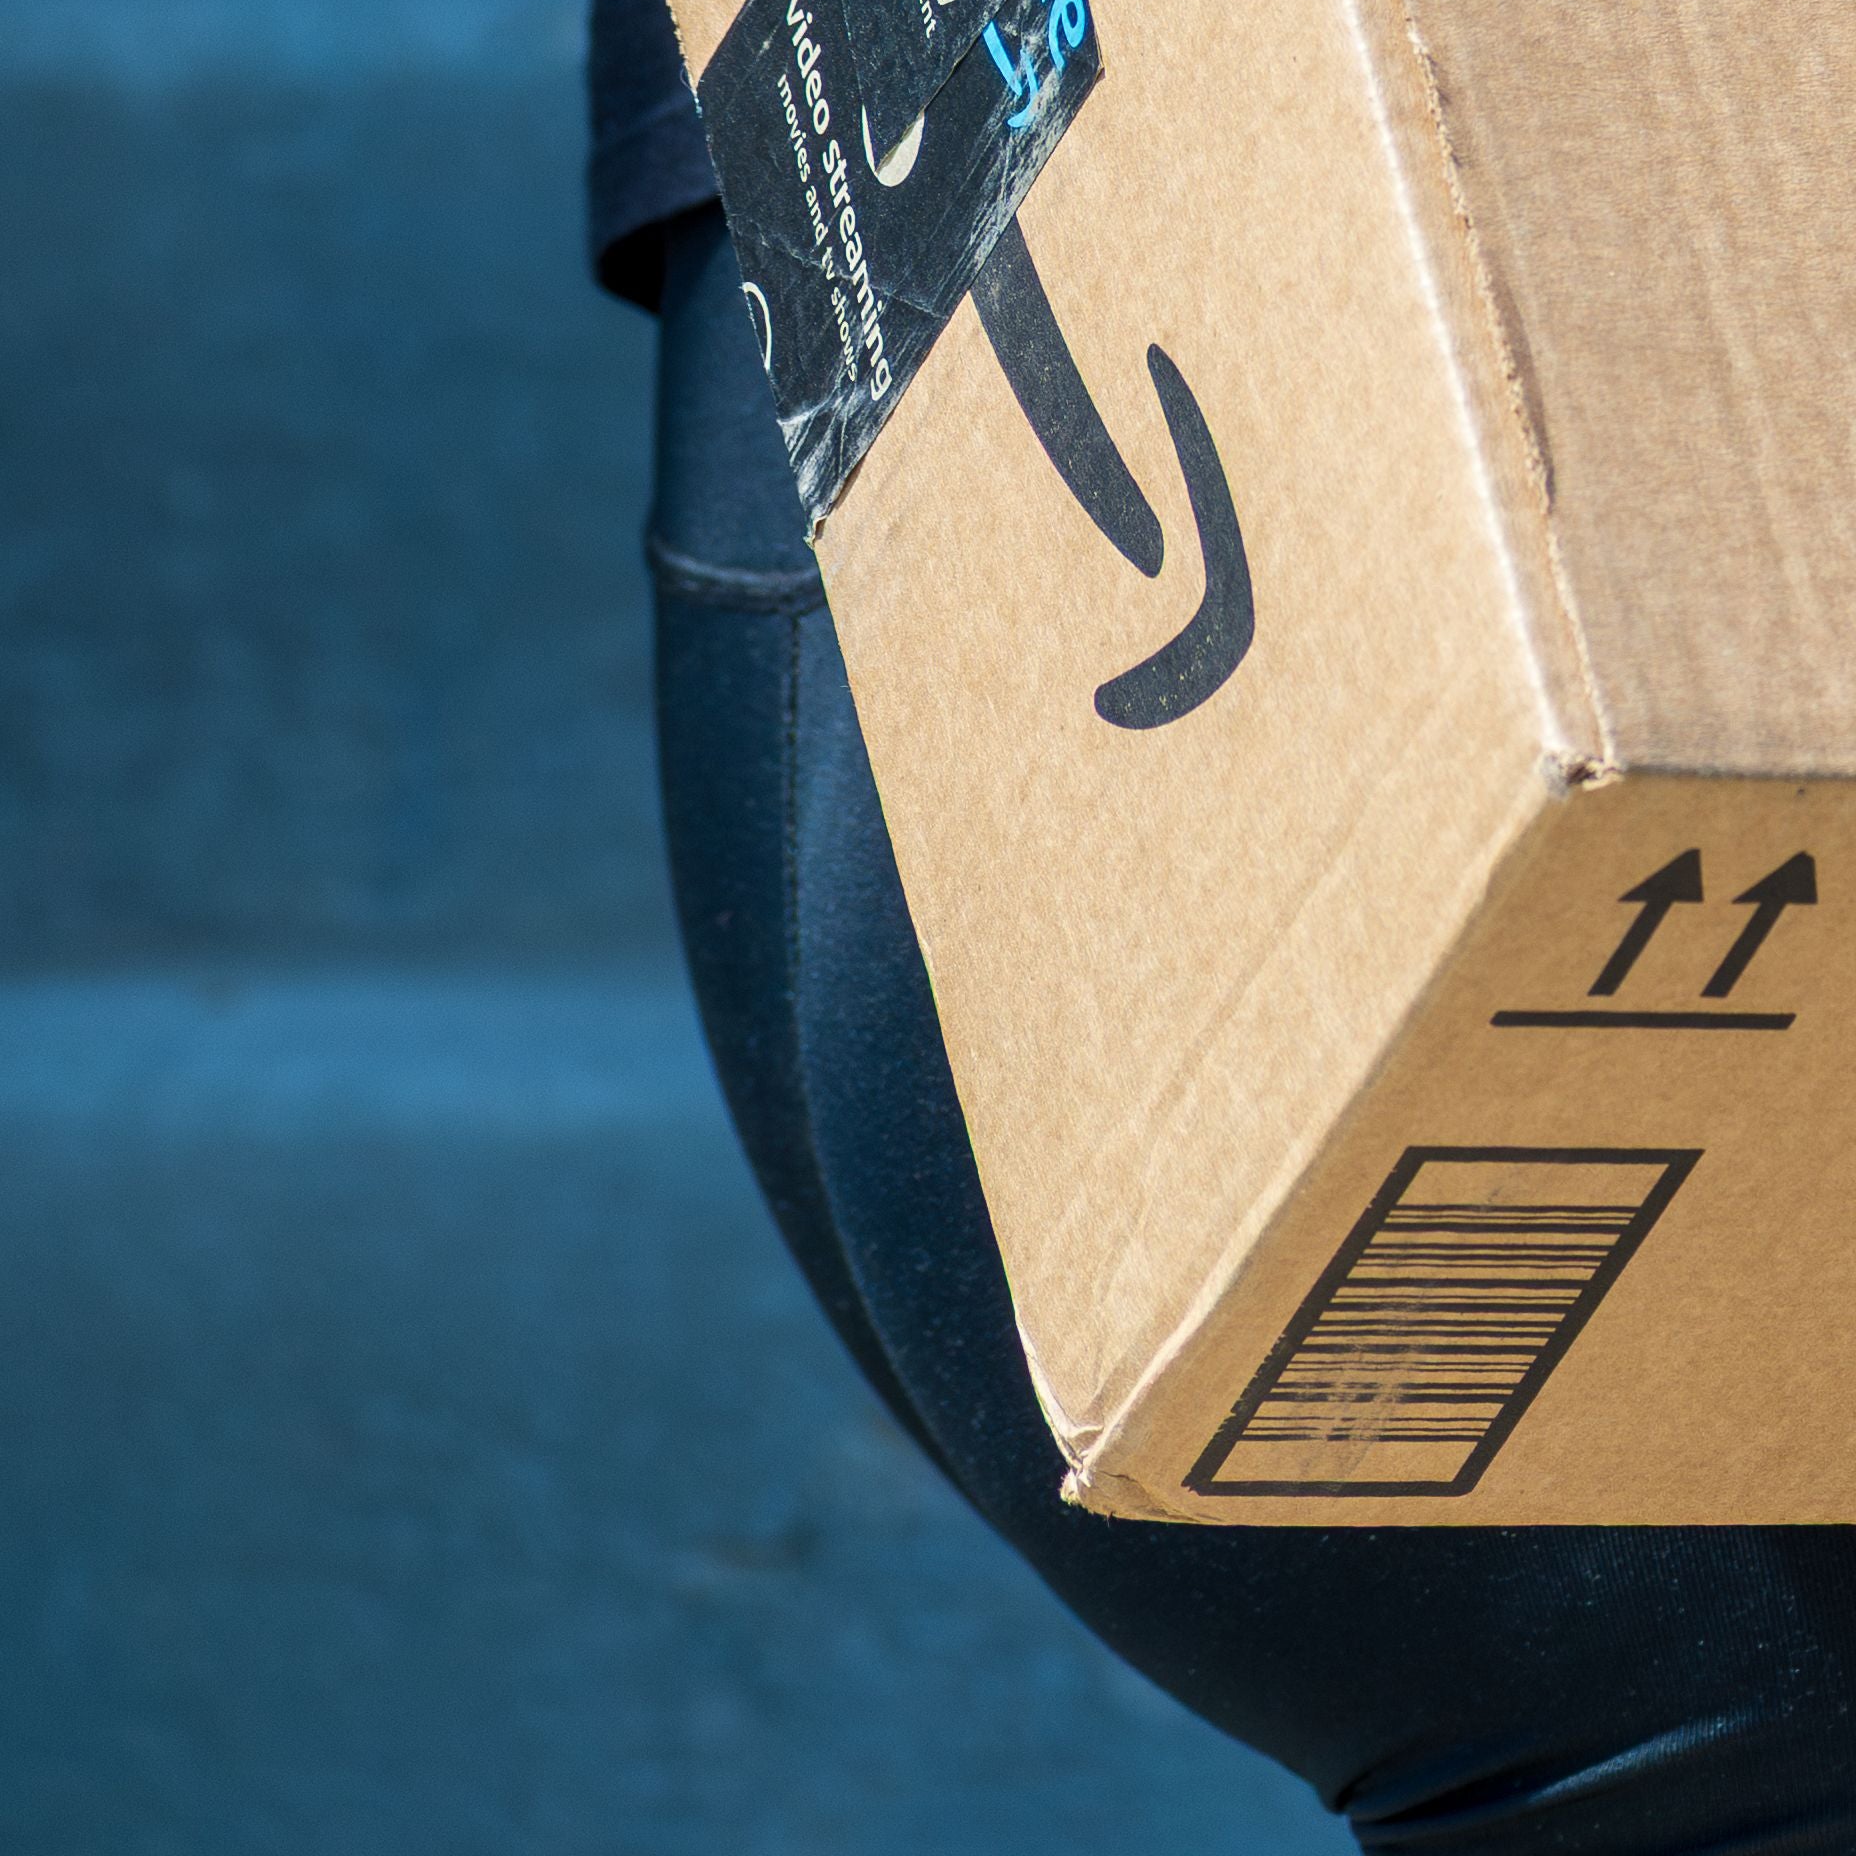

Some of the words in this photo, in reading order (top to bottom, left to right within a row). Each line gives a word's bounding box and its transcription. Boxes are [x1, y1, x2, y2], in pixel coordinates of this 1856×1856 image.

[778, 74, 808, 183] movies
[805, 188, 828, 245] and
[820, 251, 836, 282] tv
[829, 285, 859, 382] shows
[822, 138, 892, 401] streaming
